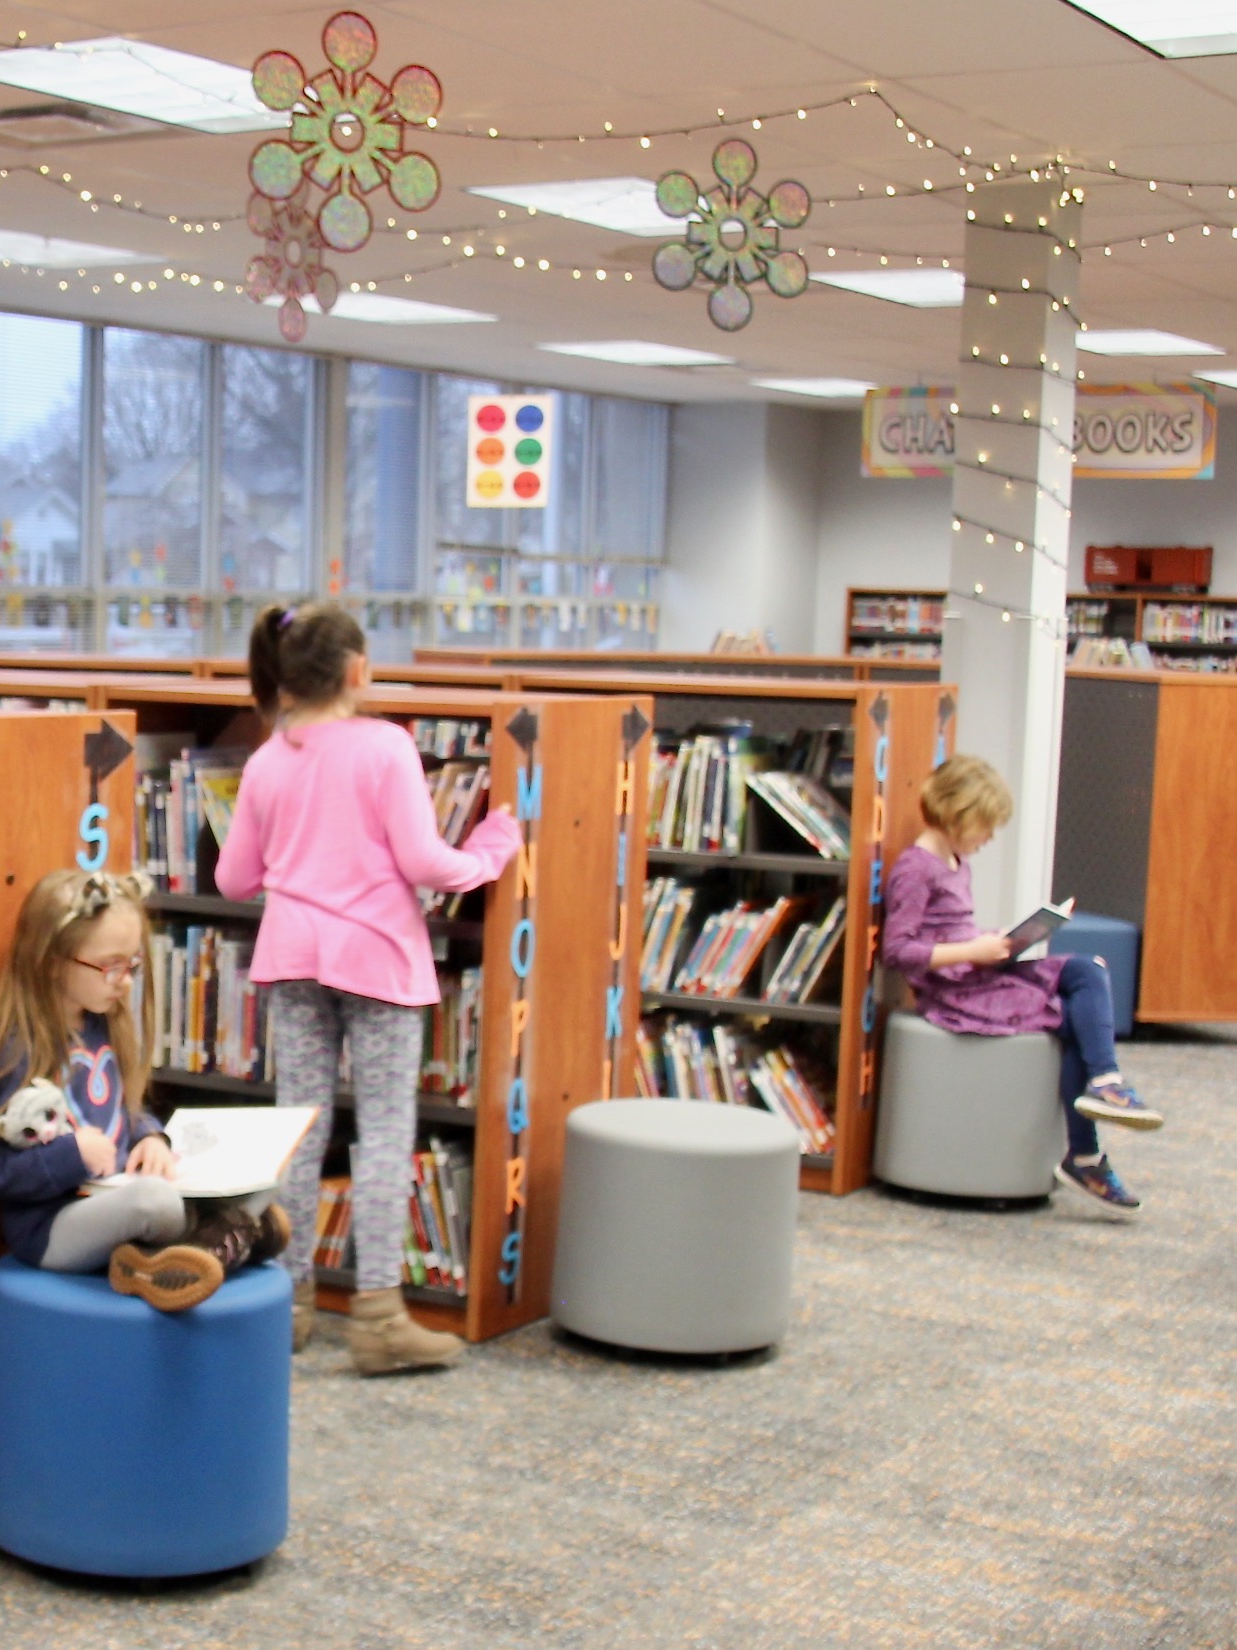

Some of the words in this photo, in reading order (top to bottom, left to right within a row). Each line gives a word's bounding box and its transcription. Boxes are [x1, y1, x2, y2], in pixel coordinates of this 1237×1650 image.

[518, 765, 541, 819] M
[616, 762, 635, 814] H
[75, 802, 110, 873] S
[517, 843, 537, 898] N
[512, 920, 535, 977] O
[610, 904, 626, 959] J
[511, 1000, 529, 1056] P
[606, 987, 623, 1039] K
[507, 1158, 525, 1214] R
[499, 1232, 520, 1284] S
